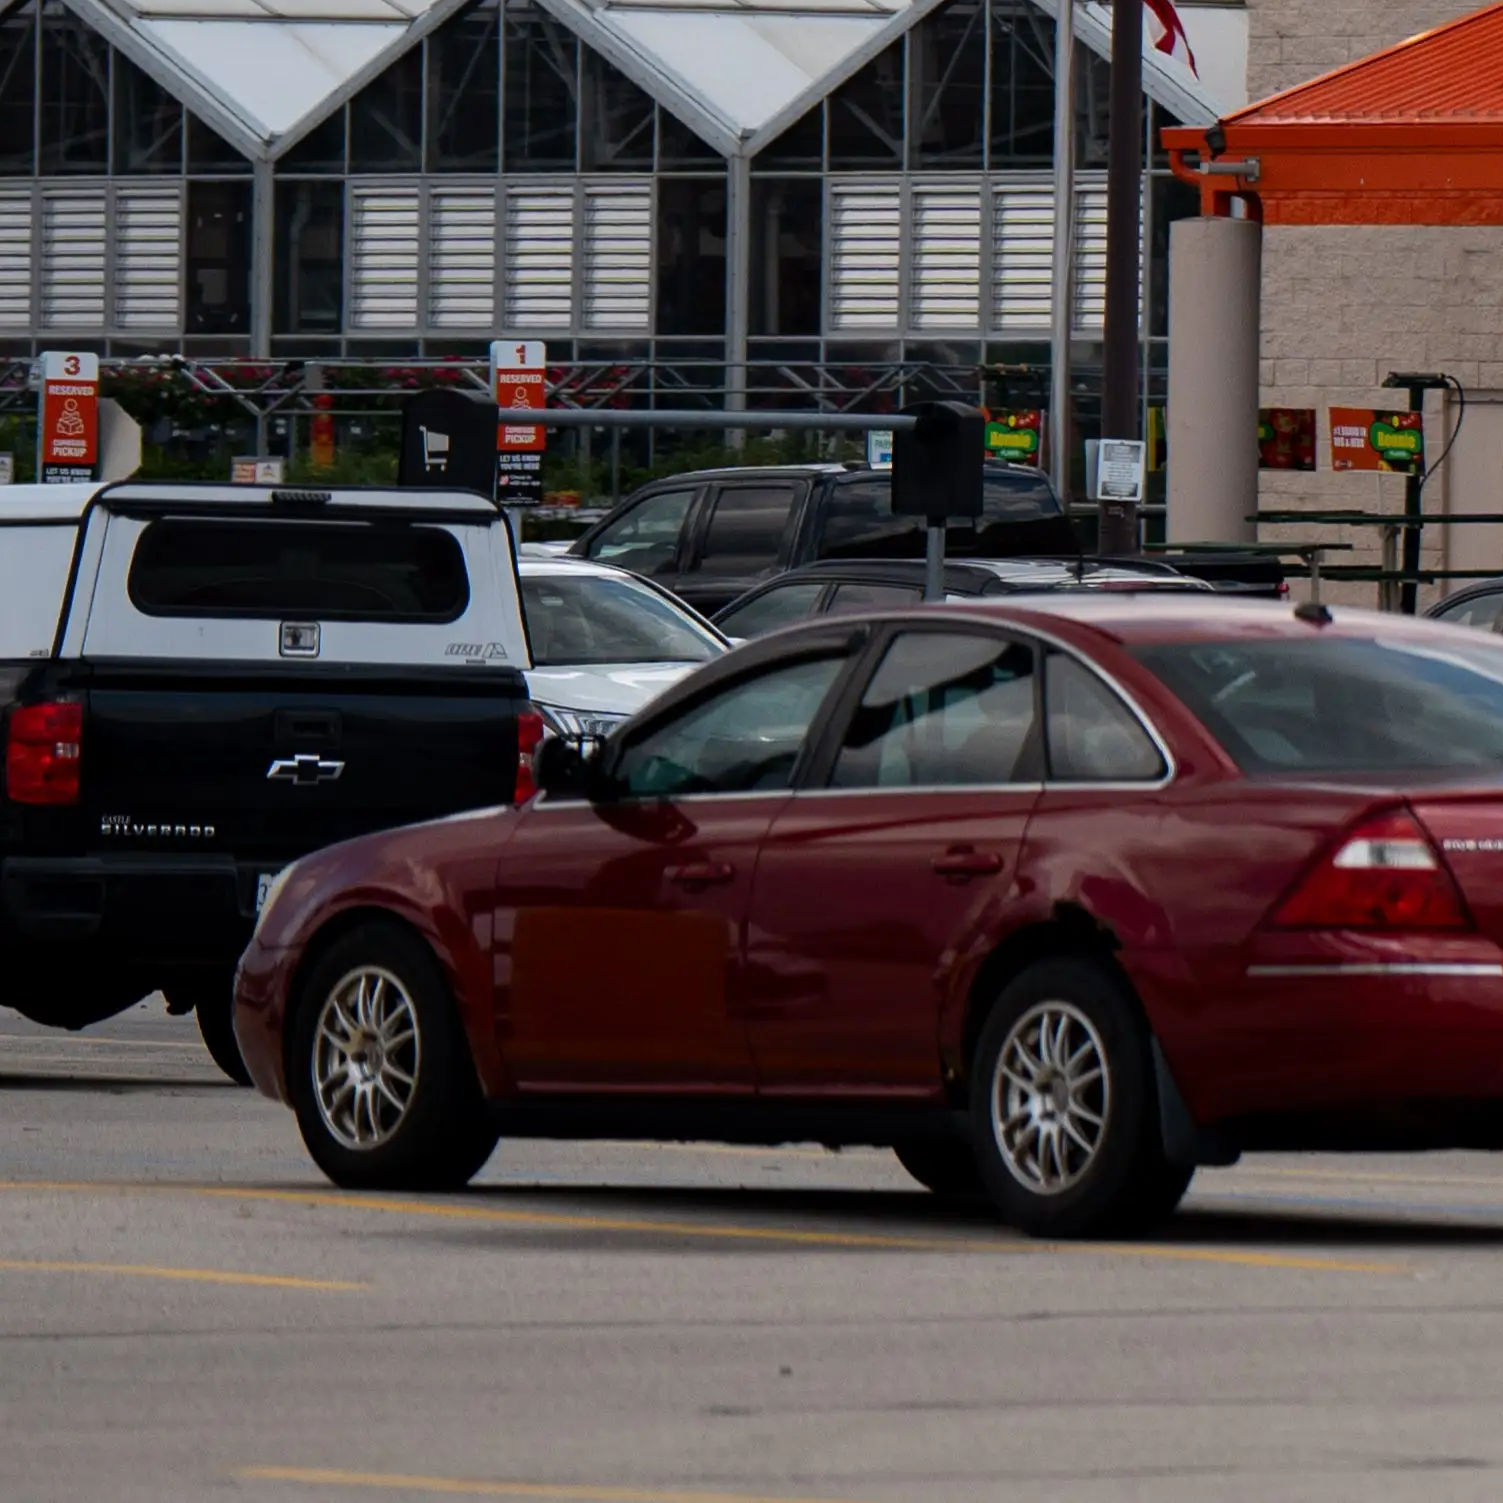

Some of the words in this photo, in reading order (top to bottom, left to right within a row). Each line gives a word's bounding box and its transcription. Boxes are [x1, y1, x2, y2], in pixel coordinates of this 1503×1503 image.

[516, 345, 526, 364] 1
[64, 356, 80, 376] 3
[500, 374, 542, 383] RESERVED
[48, 385, 94, 395] RESERVED
[990, 431, 1031, 448] Bonnie
[1377, 431, 1416, 449] Bonnie
[101, 824, 215, 836] SILVERADO
